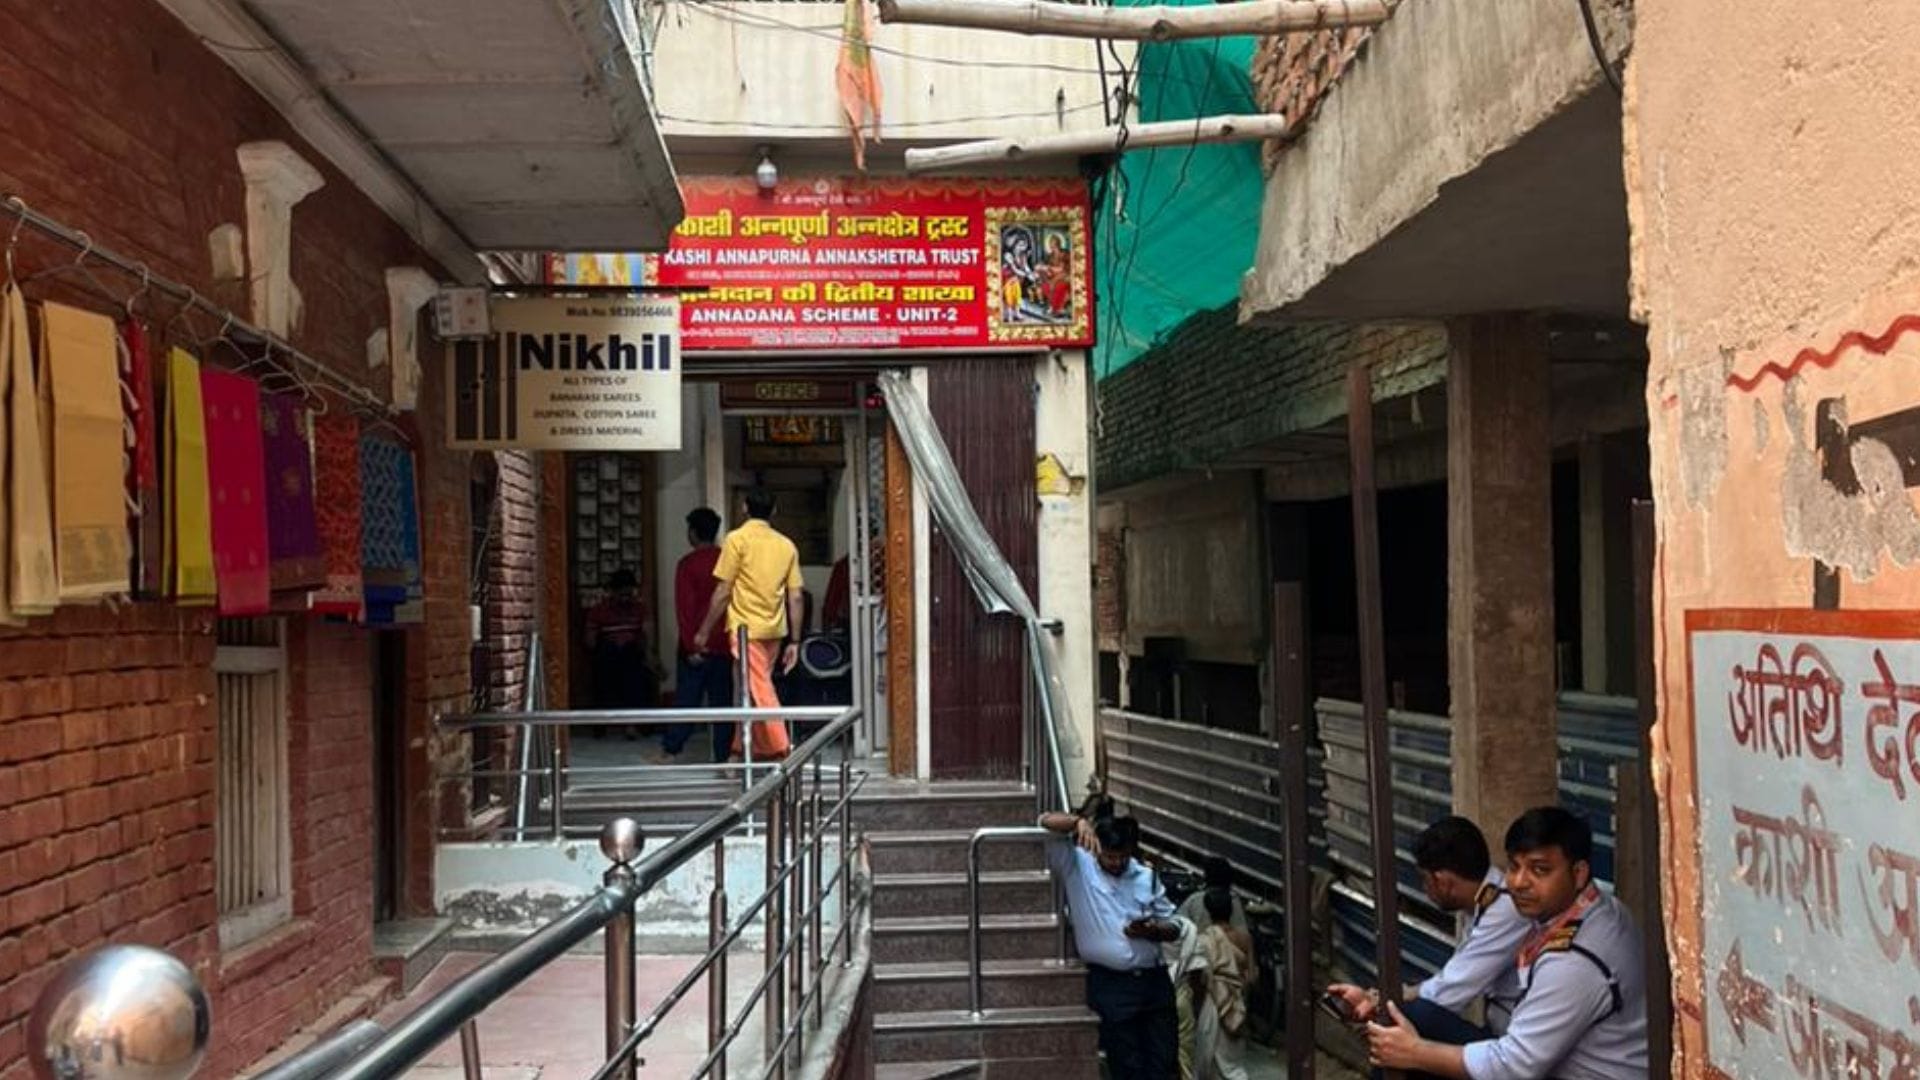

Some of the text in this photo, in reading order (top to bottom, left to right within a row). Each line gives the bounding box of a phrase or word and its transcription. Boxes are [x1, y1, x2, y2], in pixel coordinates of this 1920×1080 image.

[740, 209, 830, 246] अन्नपूर्णा
[837, 211, 921, 237] अन्नक्षेत्र
[925, 216, 970, 241] ट्रस्ट
[664, 248, 979, 265] KASHI ANNAPURNA ANNAKSHETRA TRUST
[782, 281, 817, 302] की
[690, 307, 796, 322] ANNADANA
[802, 307, 879, 322] SCHEME
[896, 307, 958, 322] UNIT-2
[520, 333, 671, 371] Nikhil
[582, 376, 612, 386] TYPES
[614, 376, 628, 386] OF
[602, 392, 642, 402] SAREES
[755, 382, 820, 400] OFFICE
[583, 409, 623, 419] COTTON
[625, 409, 656, 419] SAREE
[559, 426, 593, 436] DRESS
[595, 426, 643, 436] MATERIAL
[1728, 642, 1844, 769] अतिथि
[1732, 784, 1844, 938] काशी
